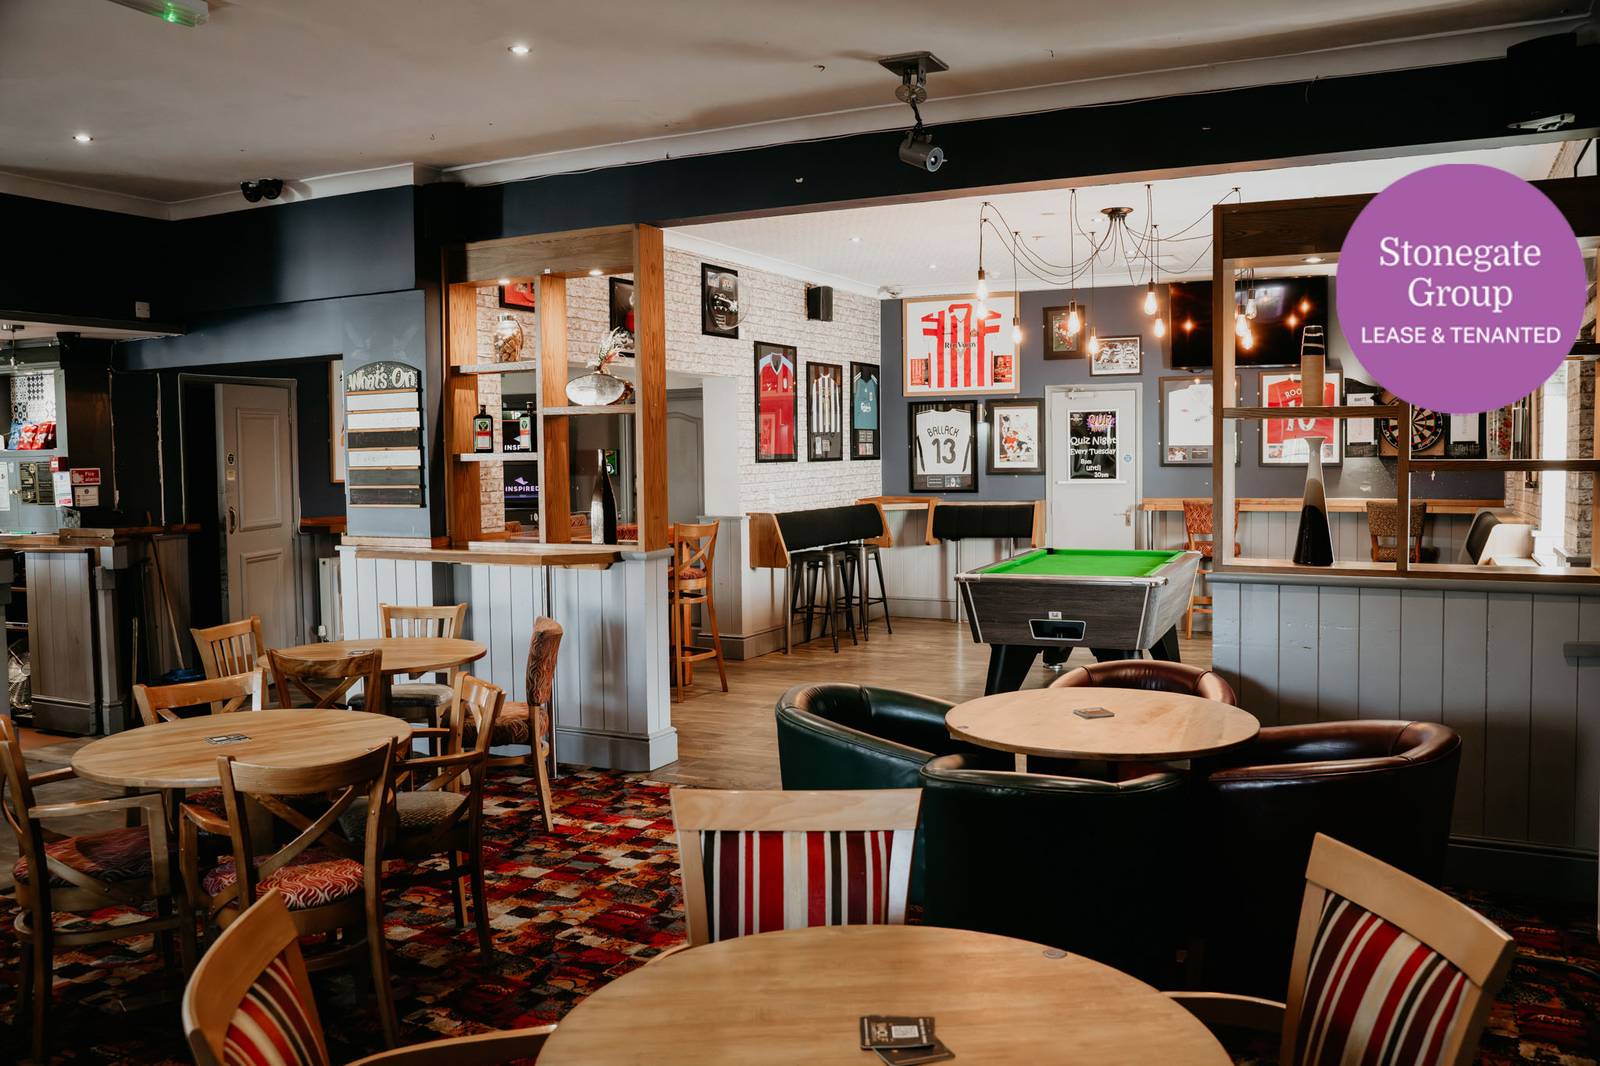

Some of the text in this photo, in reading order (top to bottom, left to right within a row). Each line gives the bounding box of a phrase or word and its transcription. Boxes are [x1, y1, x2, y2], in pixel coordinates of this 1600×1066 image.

[348, 363, 415, 391] What's On
[1287, 400, 1316, 431] 10
[926, 424, 960, 438] BALLACK
[1071, 436, 1091, 446] Quiz
[931, 438, 957, 464] 13
[1071, 448, 1117, 456] Every Tuesday
